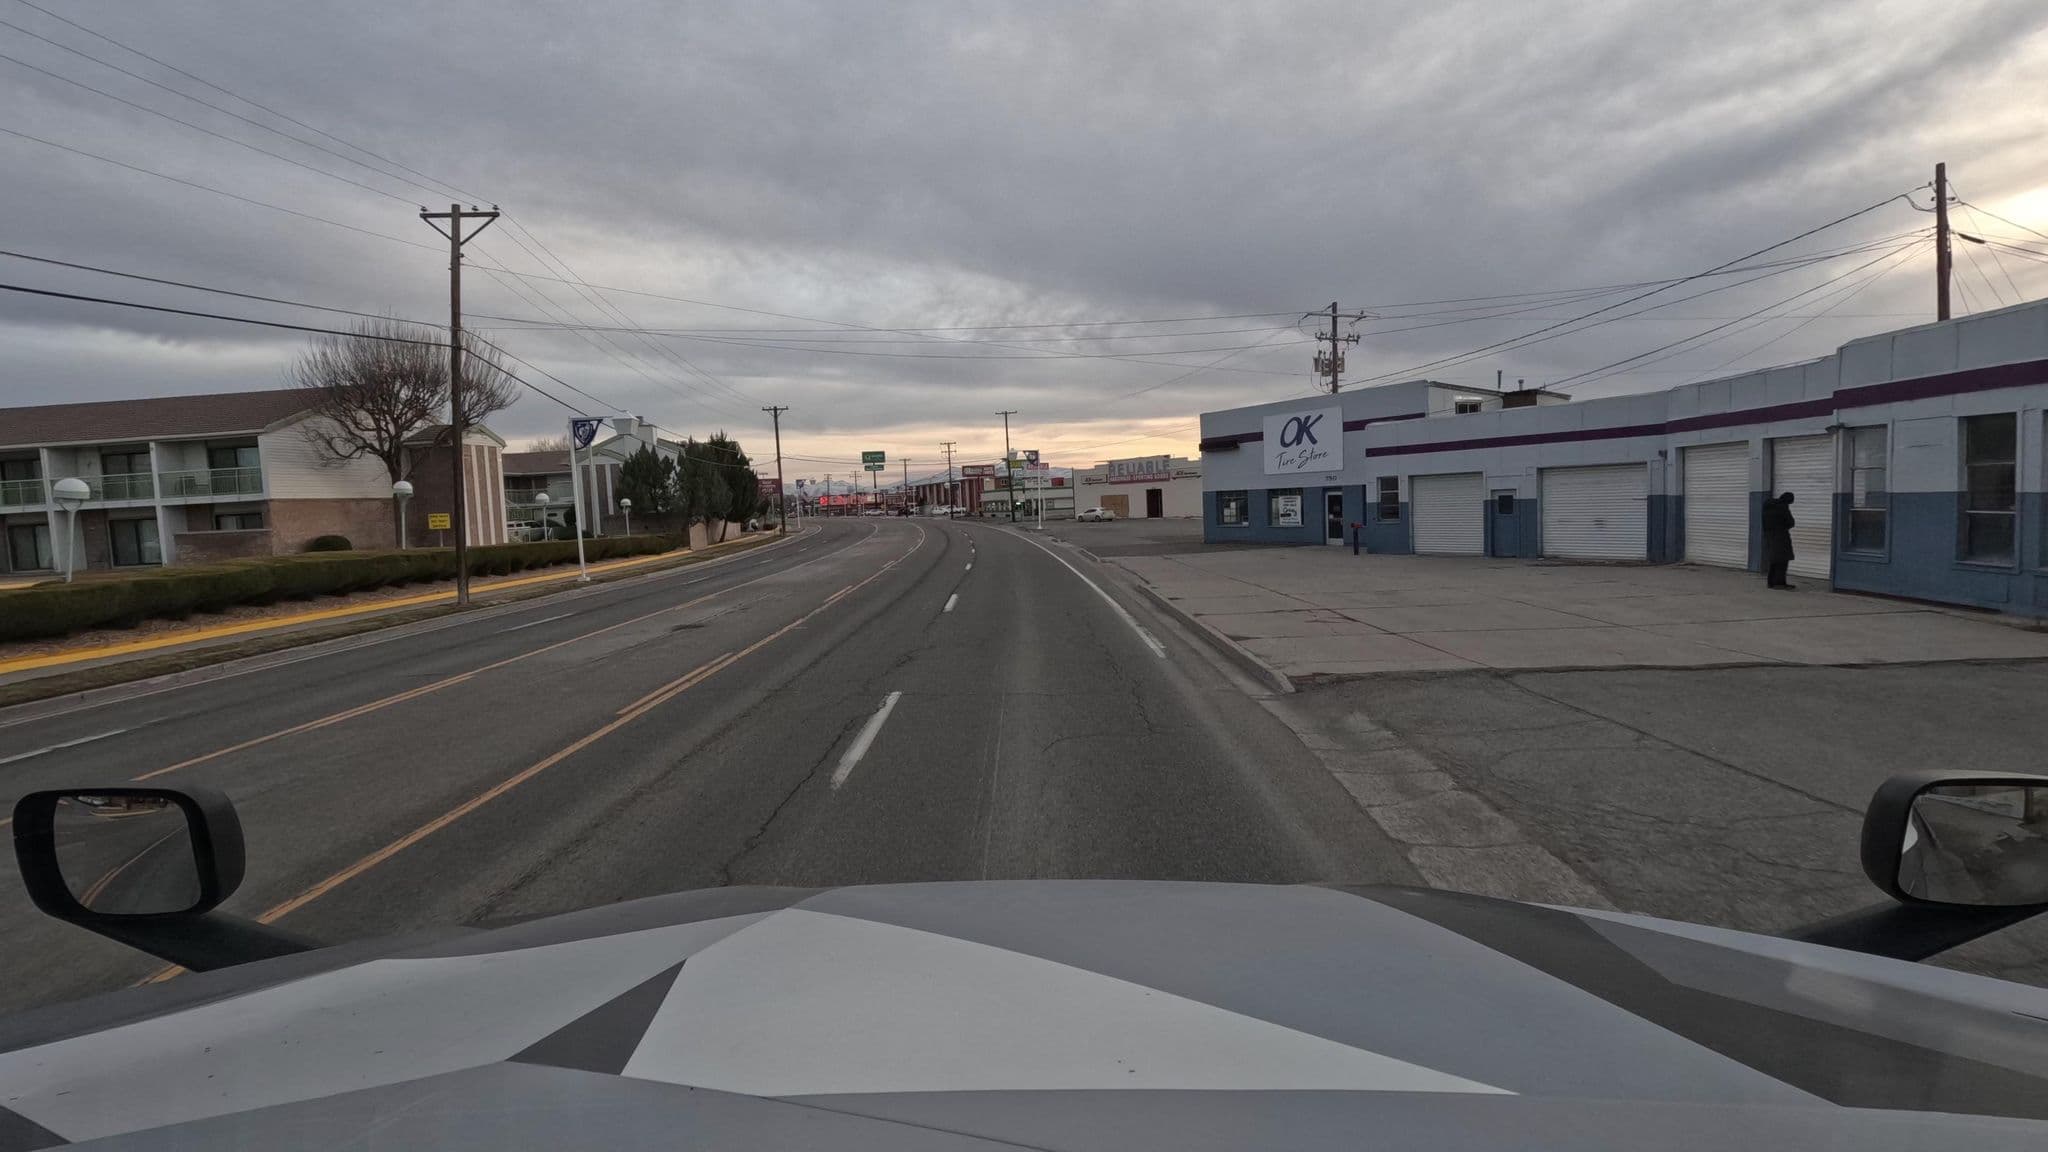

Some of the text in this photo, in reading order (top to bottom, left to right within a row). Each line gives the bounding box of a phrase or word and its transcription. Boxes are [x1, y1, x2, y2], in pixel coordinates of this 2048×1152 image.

[1280, 414, 1323, 448] OK
[1109, 459, 1170, 476] RELIABLE
[1274, 447, 1328, 469] Tire Store
